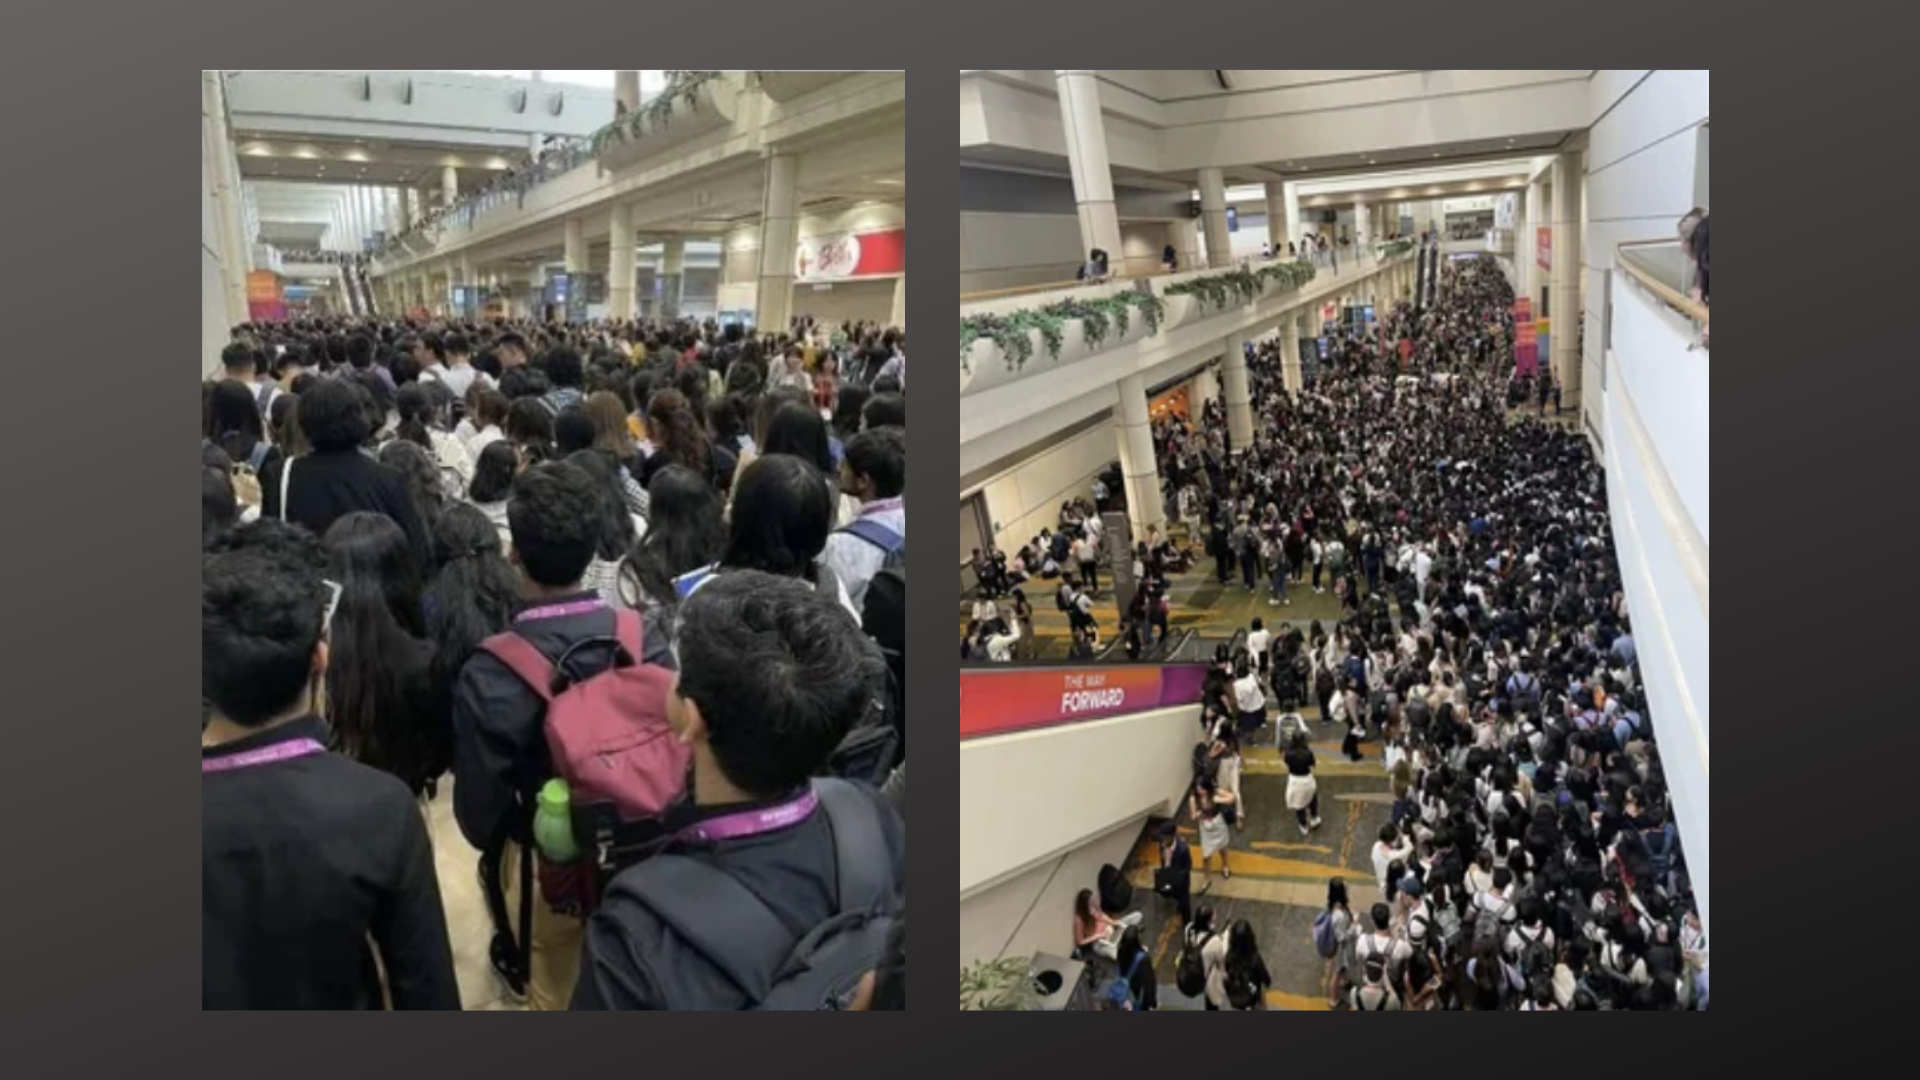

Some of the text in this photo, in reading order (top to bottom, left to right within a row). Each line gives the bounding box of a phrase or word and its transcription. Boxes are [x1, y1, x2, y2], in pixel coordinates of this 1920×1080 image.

[1064, 674, 1106, 689] THE WAY
[1062, 687, 1124, 713] FORWARD
